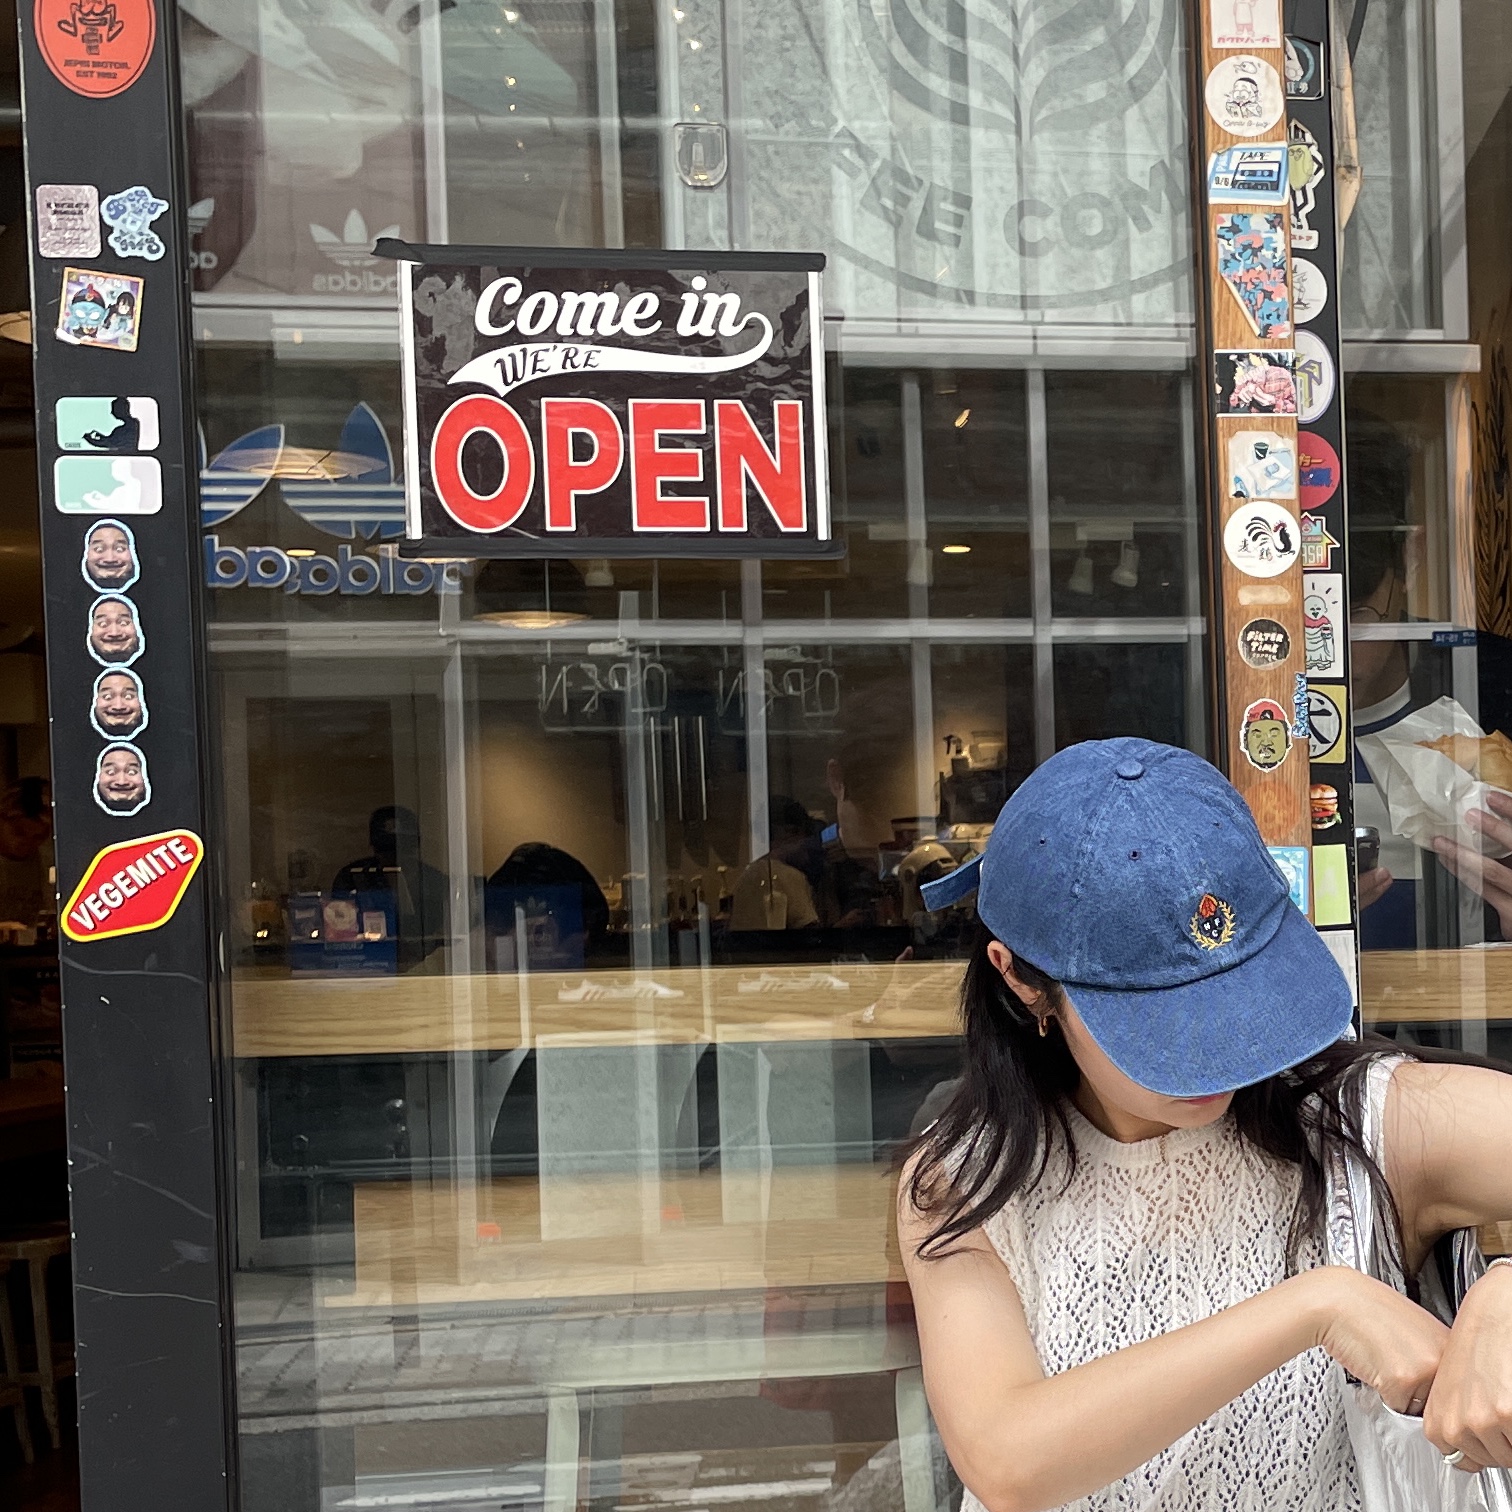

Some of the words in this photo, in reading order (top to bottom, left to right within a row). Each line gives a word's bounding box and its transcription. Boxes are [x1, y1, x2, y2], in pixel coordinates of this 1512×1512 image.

[474, 276, 662, 338] Come
[676, 277, 752, 338] in
[494, 345, 602, 390] WE'RE
[431, 394, 808, 534] OPEN
[70, 838, 194, 931] VEGEMITE
